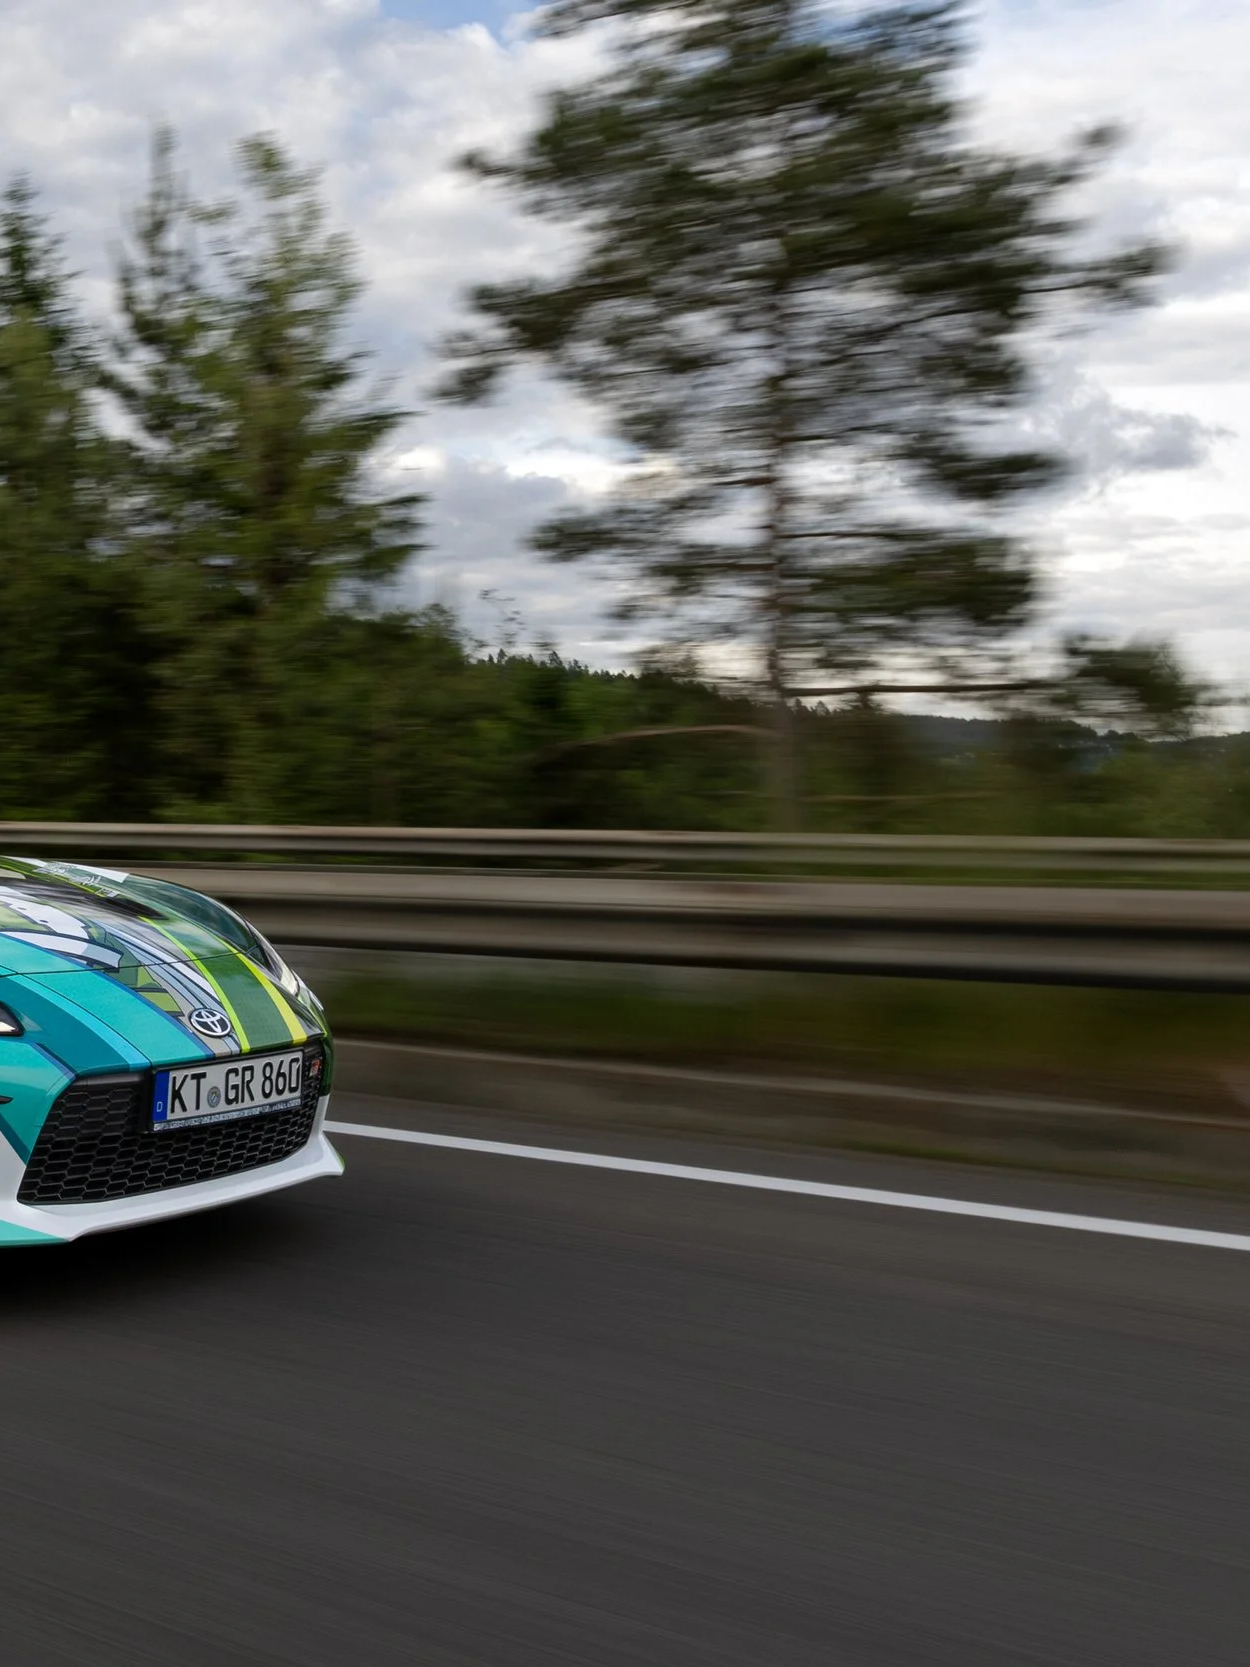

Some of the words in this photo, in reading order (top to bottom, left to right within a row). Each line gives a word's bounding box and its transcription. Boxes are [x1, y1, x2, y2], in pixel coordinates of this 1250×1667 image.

[169, 1072, 207, 1114] KT
[224, 1065, 255, 1105] GR
[261, 1057, 300, 1099] 860
[156, 1101, 163, 1112] D
